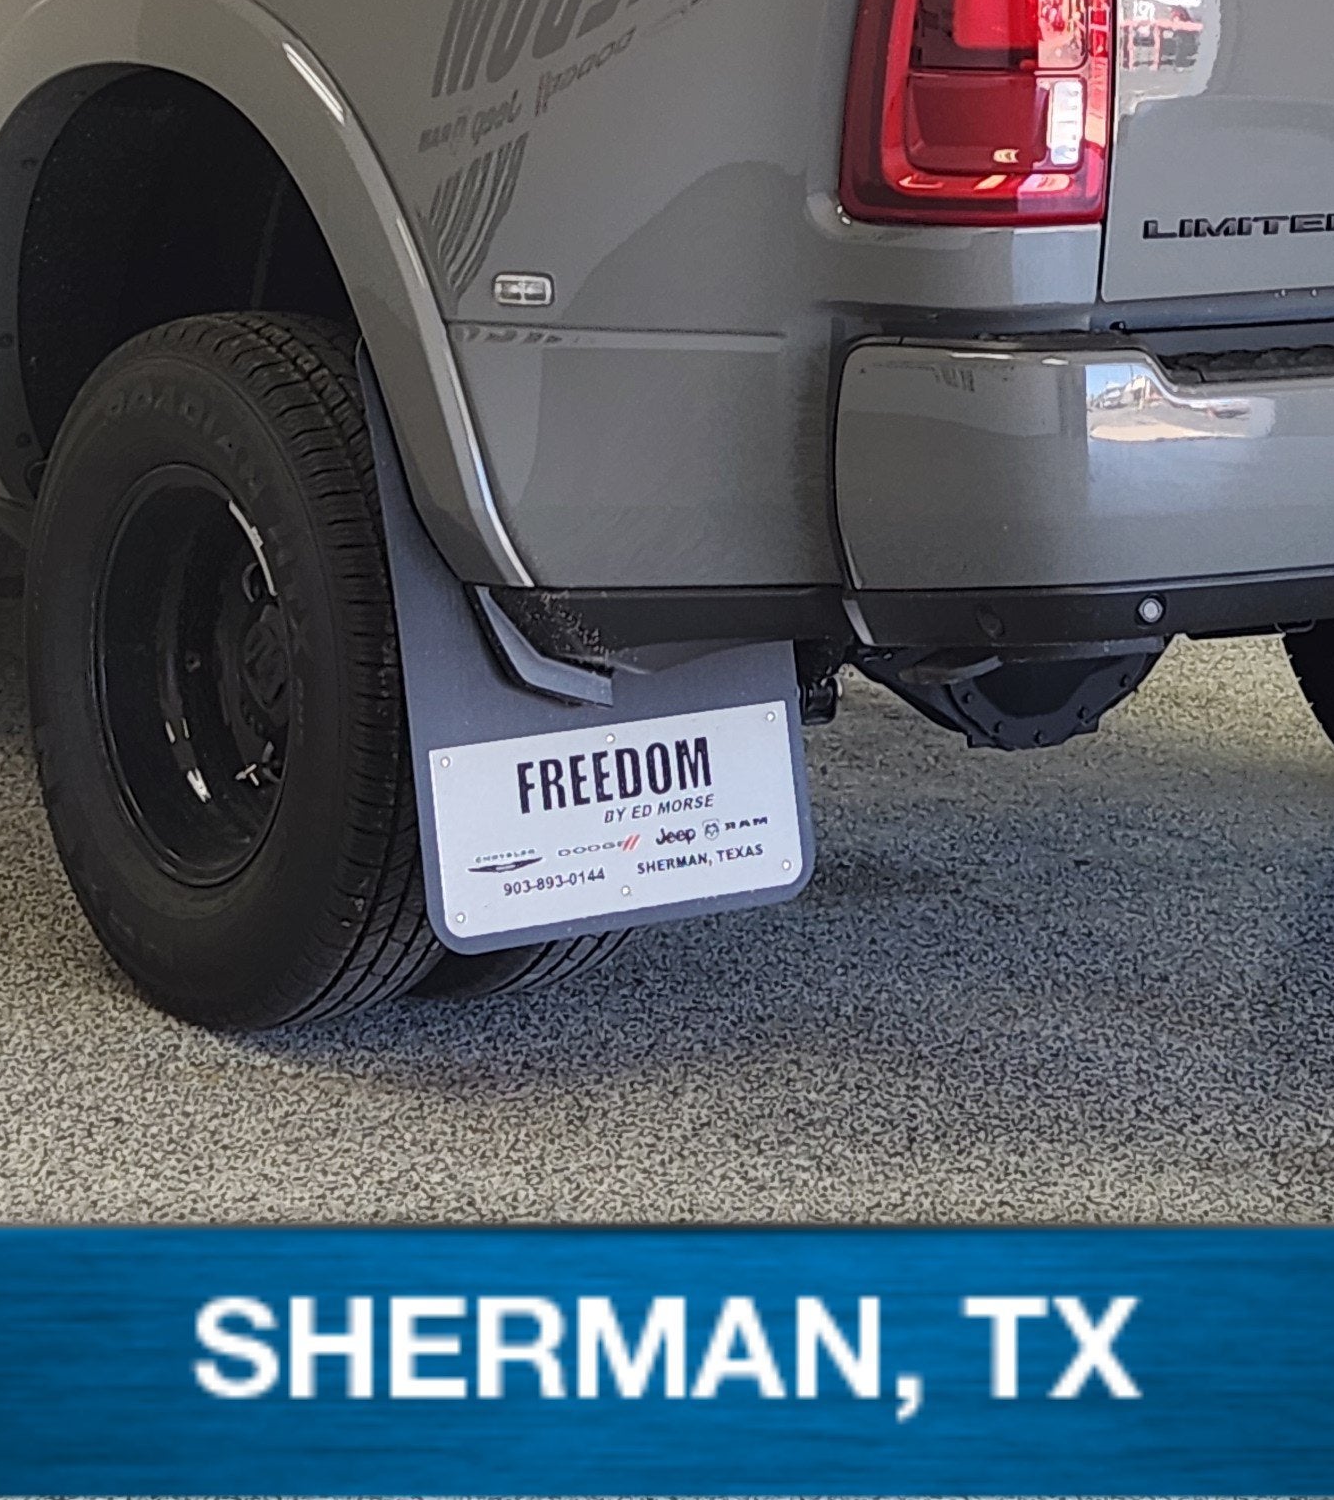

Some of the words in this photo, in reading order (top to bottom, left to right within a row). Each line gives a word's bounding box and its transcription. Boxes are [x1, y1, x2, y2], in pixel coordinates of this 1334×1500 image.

[517, 736, 713, 815] FREEDOM
[603, 806, 627, 824] BY
[631, 804, 652, 820] ED
[657, 793, 715, 816] MORSE
[655, 827, 697, 846] Jeep
[724, 816, 769, 832] RAM
[503, 867, 606, 897] 903-893-0144
[637, 853, 713, 875] SHERMAN,
[715, 843, 764, 863] TEXAS
